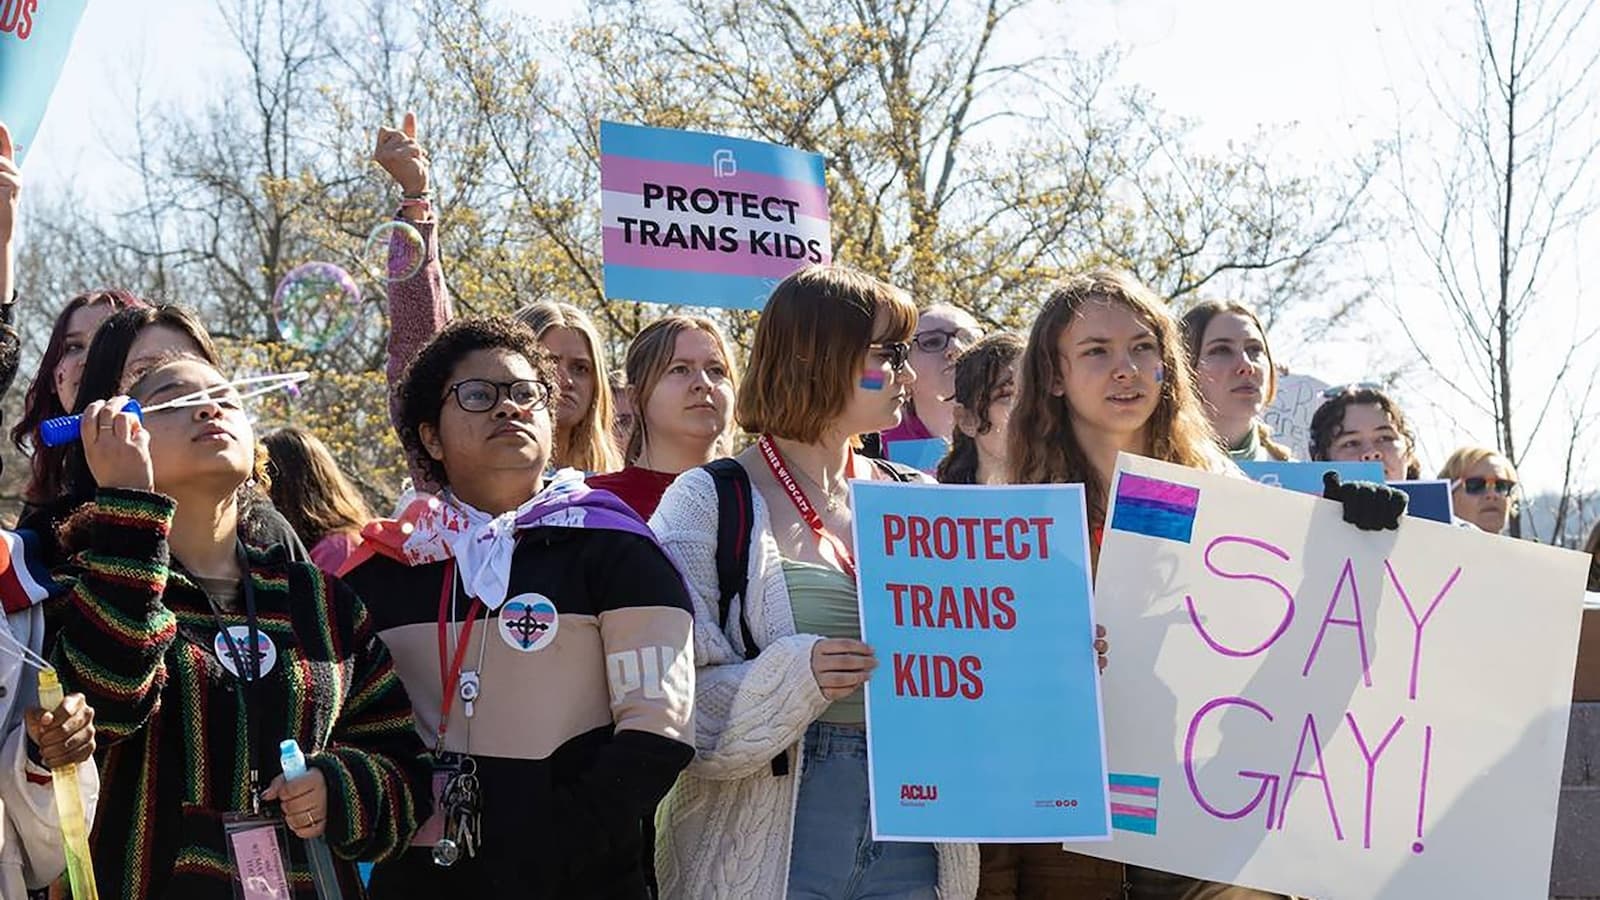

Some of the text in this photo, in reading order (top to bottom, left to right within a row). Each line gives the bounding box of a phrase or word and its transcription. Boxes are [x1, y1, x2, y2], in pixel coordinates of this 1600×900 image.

[643, 182, 800, 225] PROTECT
[617, 216, 823, 265] TRANS KIDS
[777, 466, 810, 515] WILDCATS
[884, 514, 1053, 560] PROTECT
[886, 584, 1017, 630] TRANS
[1185, 535, 1462, 700] SAY
[893, 653, 984, 700] KIDS
[900, 784, 938, 801] ACLU
[1183, 696, 1432, 854] GAY!
